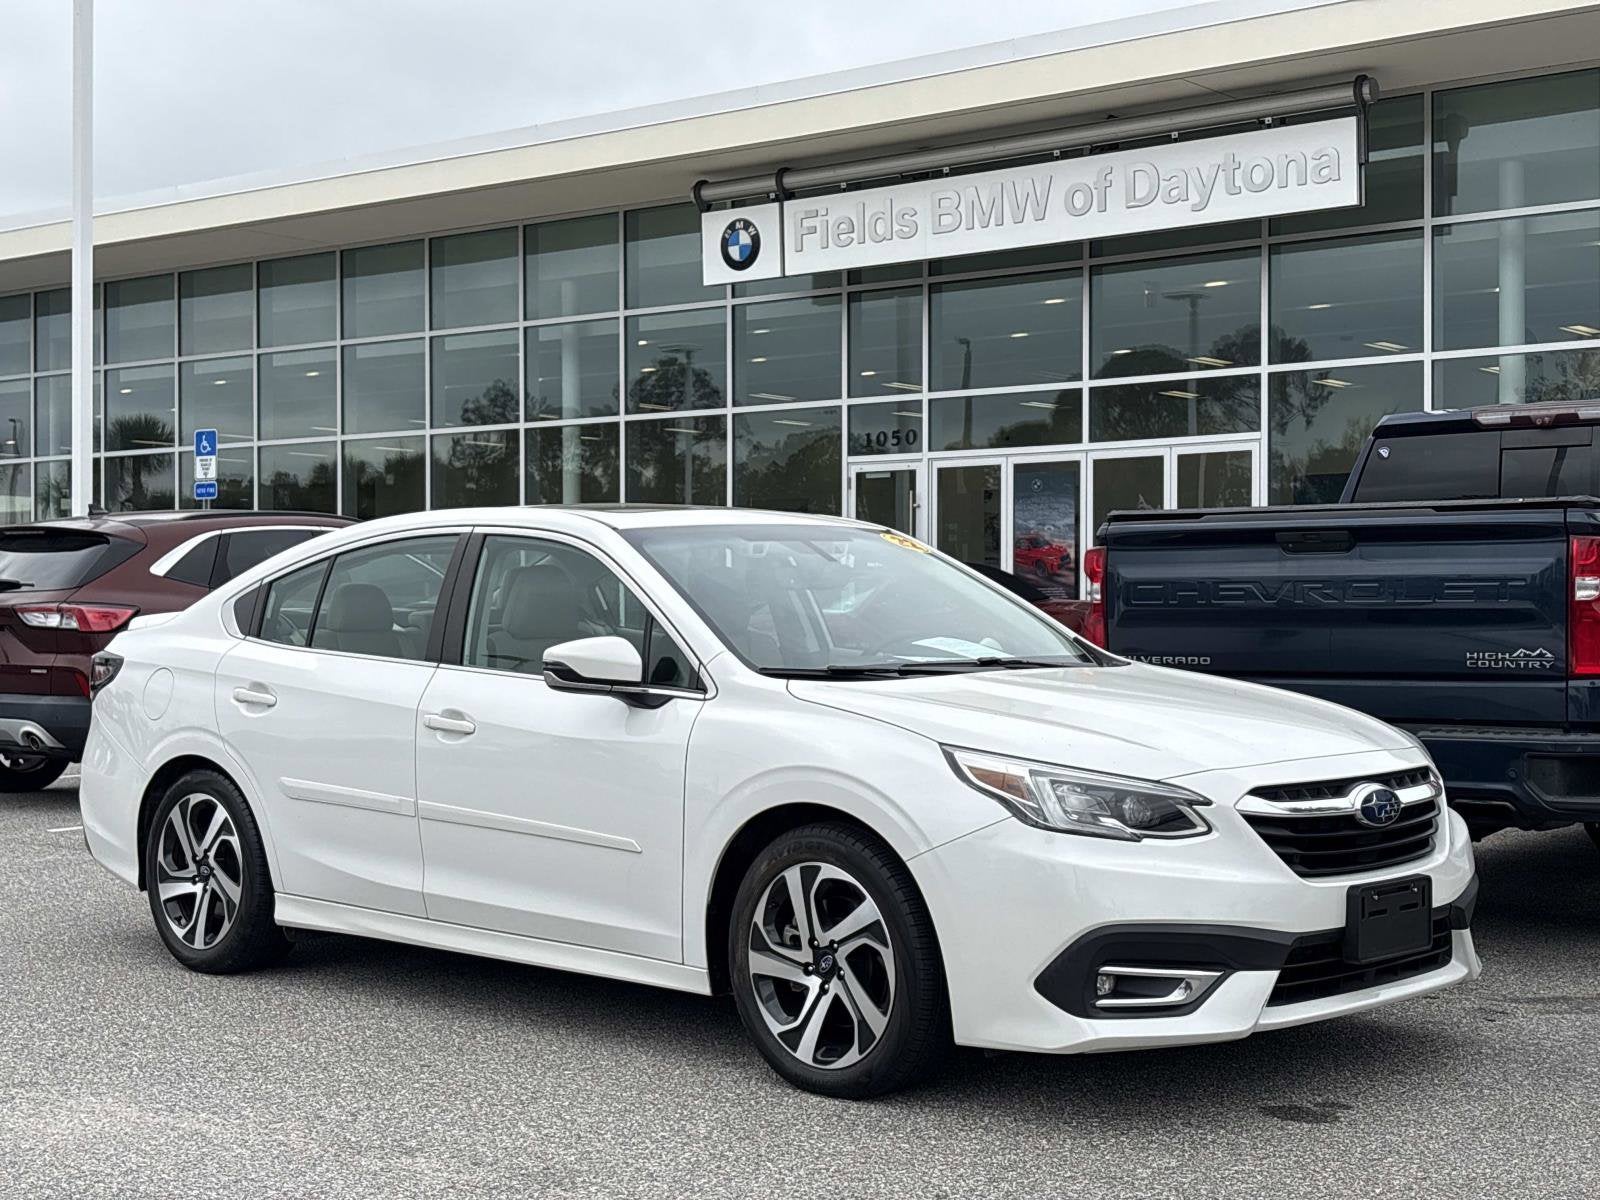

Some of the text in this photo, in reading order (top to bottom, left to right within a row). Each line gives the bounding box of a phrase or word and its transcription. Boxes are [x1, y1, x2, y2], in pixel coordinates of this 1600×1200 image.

[793, 146, 1342, 253] Fields BMW of Daytona
[724, 220, 758, 239] BMW
[864, 429, 917, 448] 1050
[1127, 578, 1528, 606] CHEVROLET
[1466, 652, 1509, 660] HIGH
[1466, 660, 1555, 669] COUNTRY
